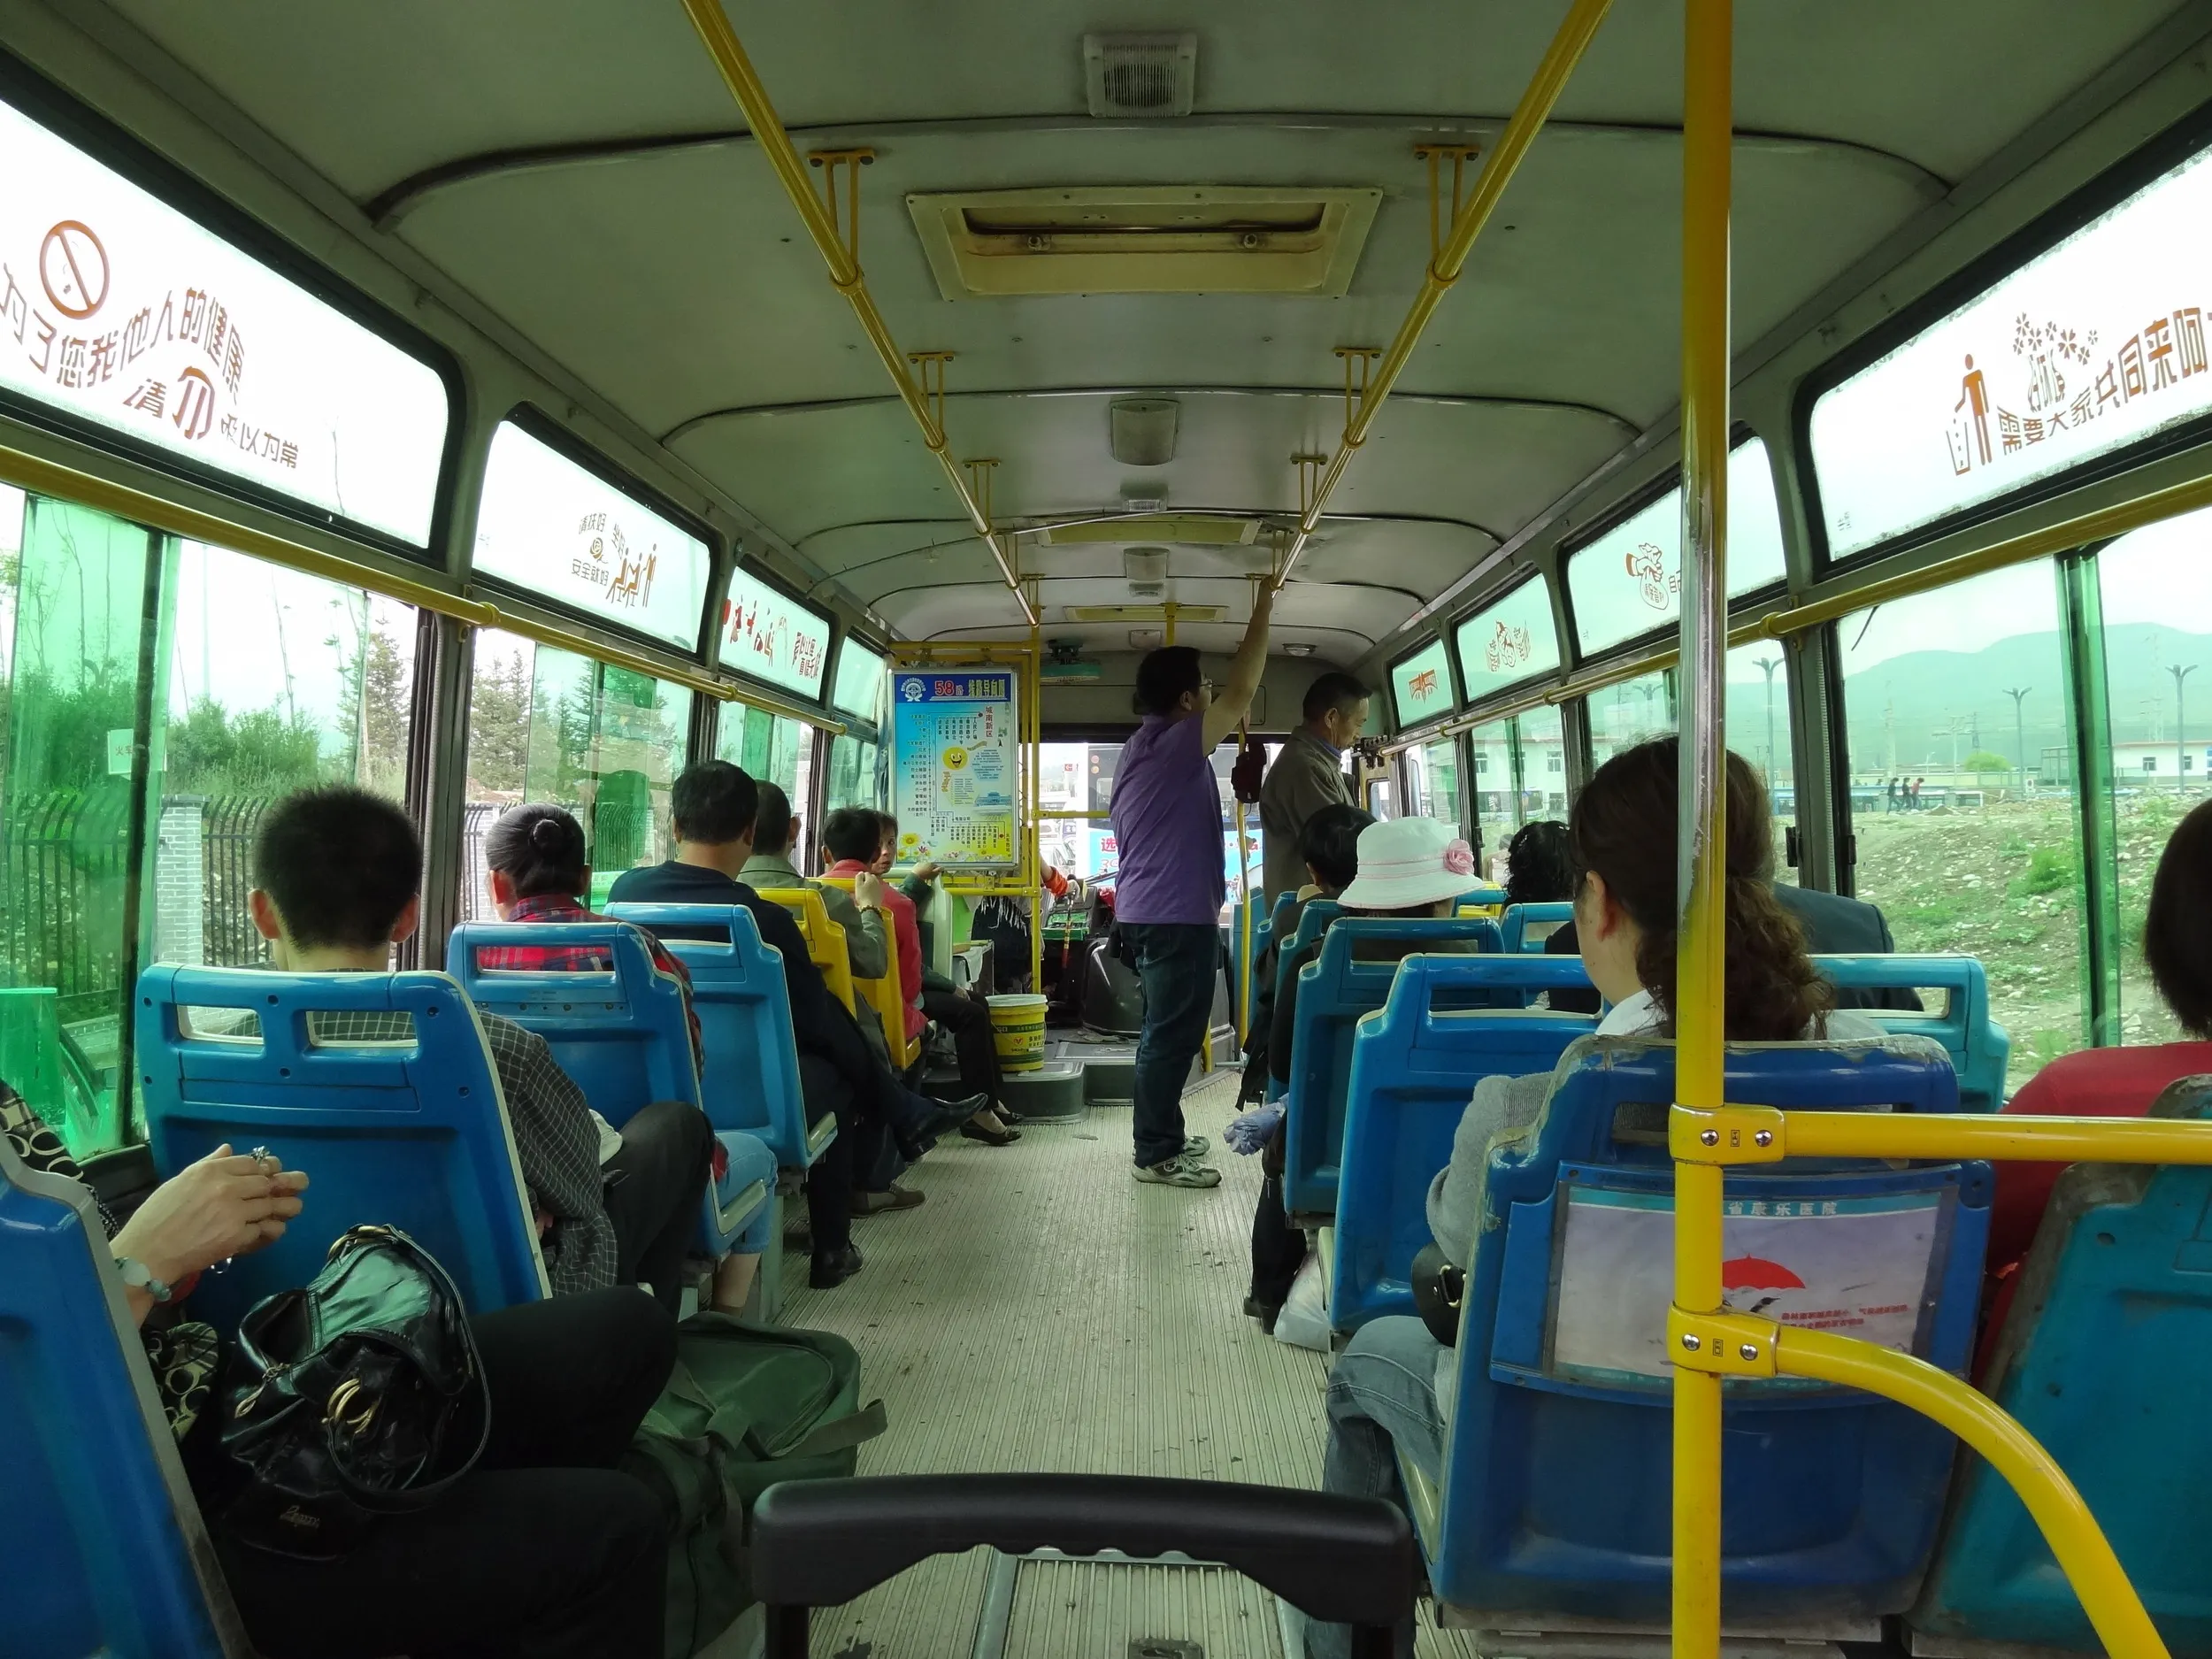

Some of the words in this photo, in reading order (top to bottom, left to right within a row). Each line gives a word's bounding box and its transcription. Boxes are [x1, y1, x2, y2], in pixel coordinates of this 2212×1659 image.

[1996, 306, 2212, 457] 需要大家共同来呵
[571, 558, 610, 587] 安全就好
[1728, 1201, 1838, 1217] 省康乐医院
